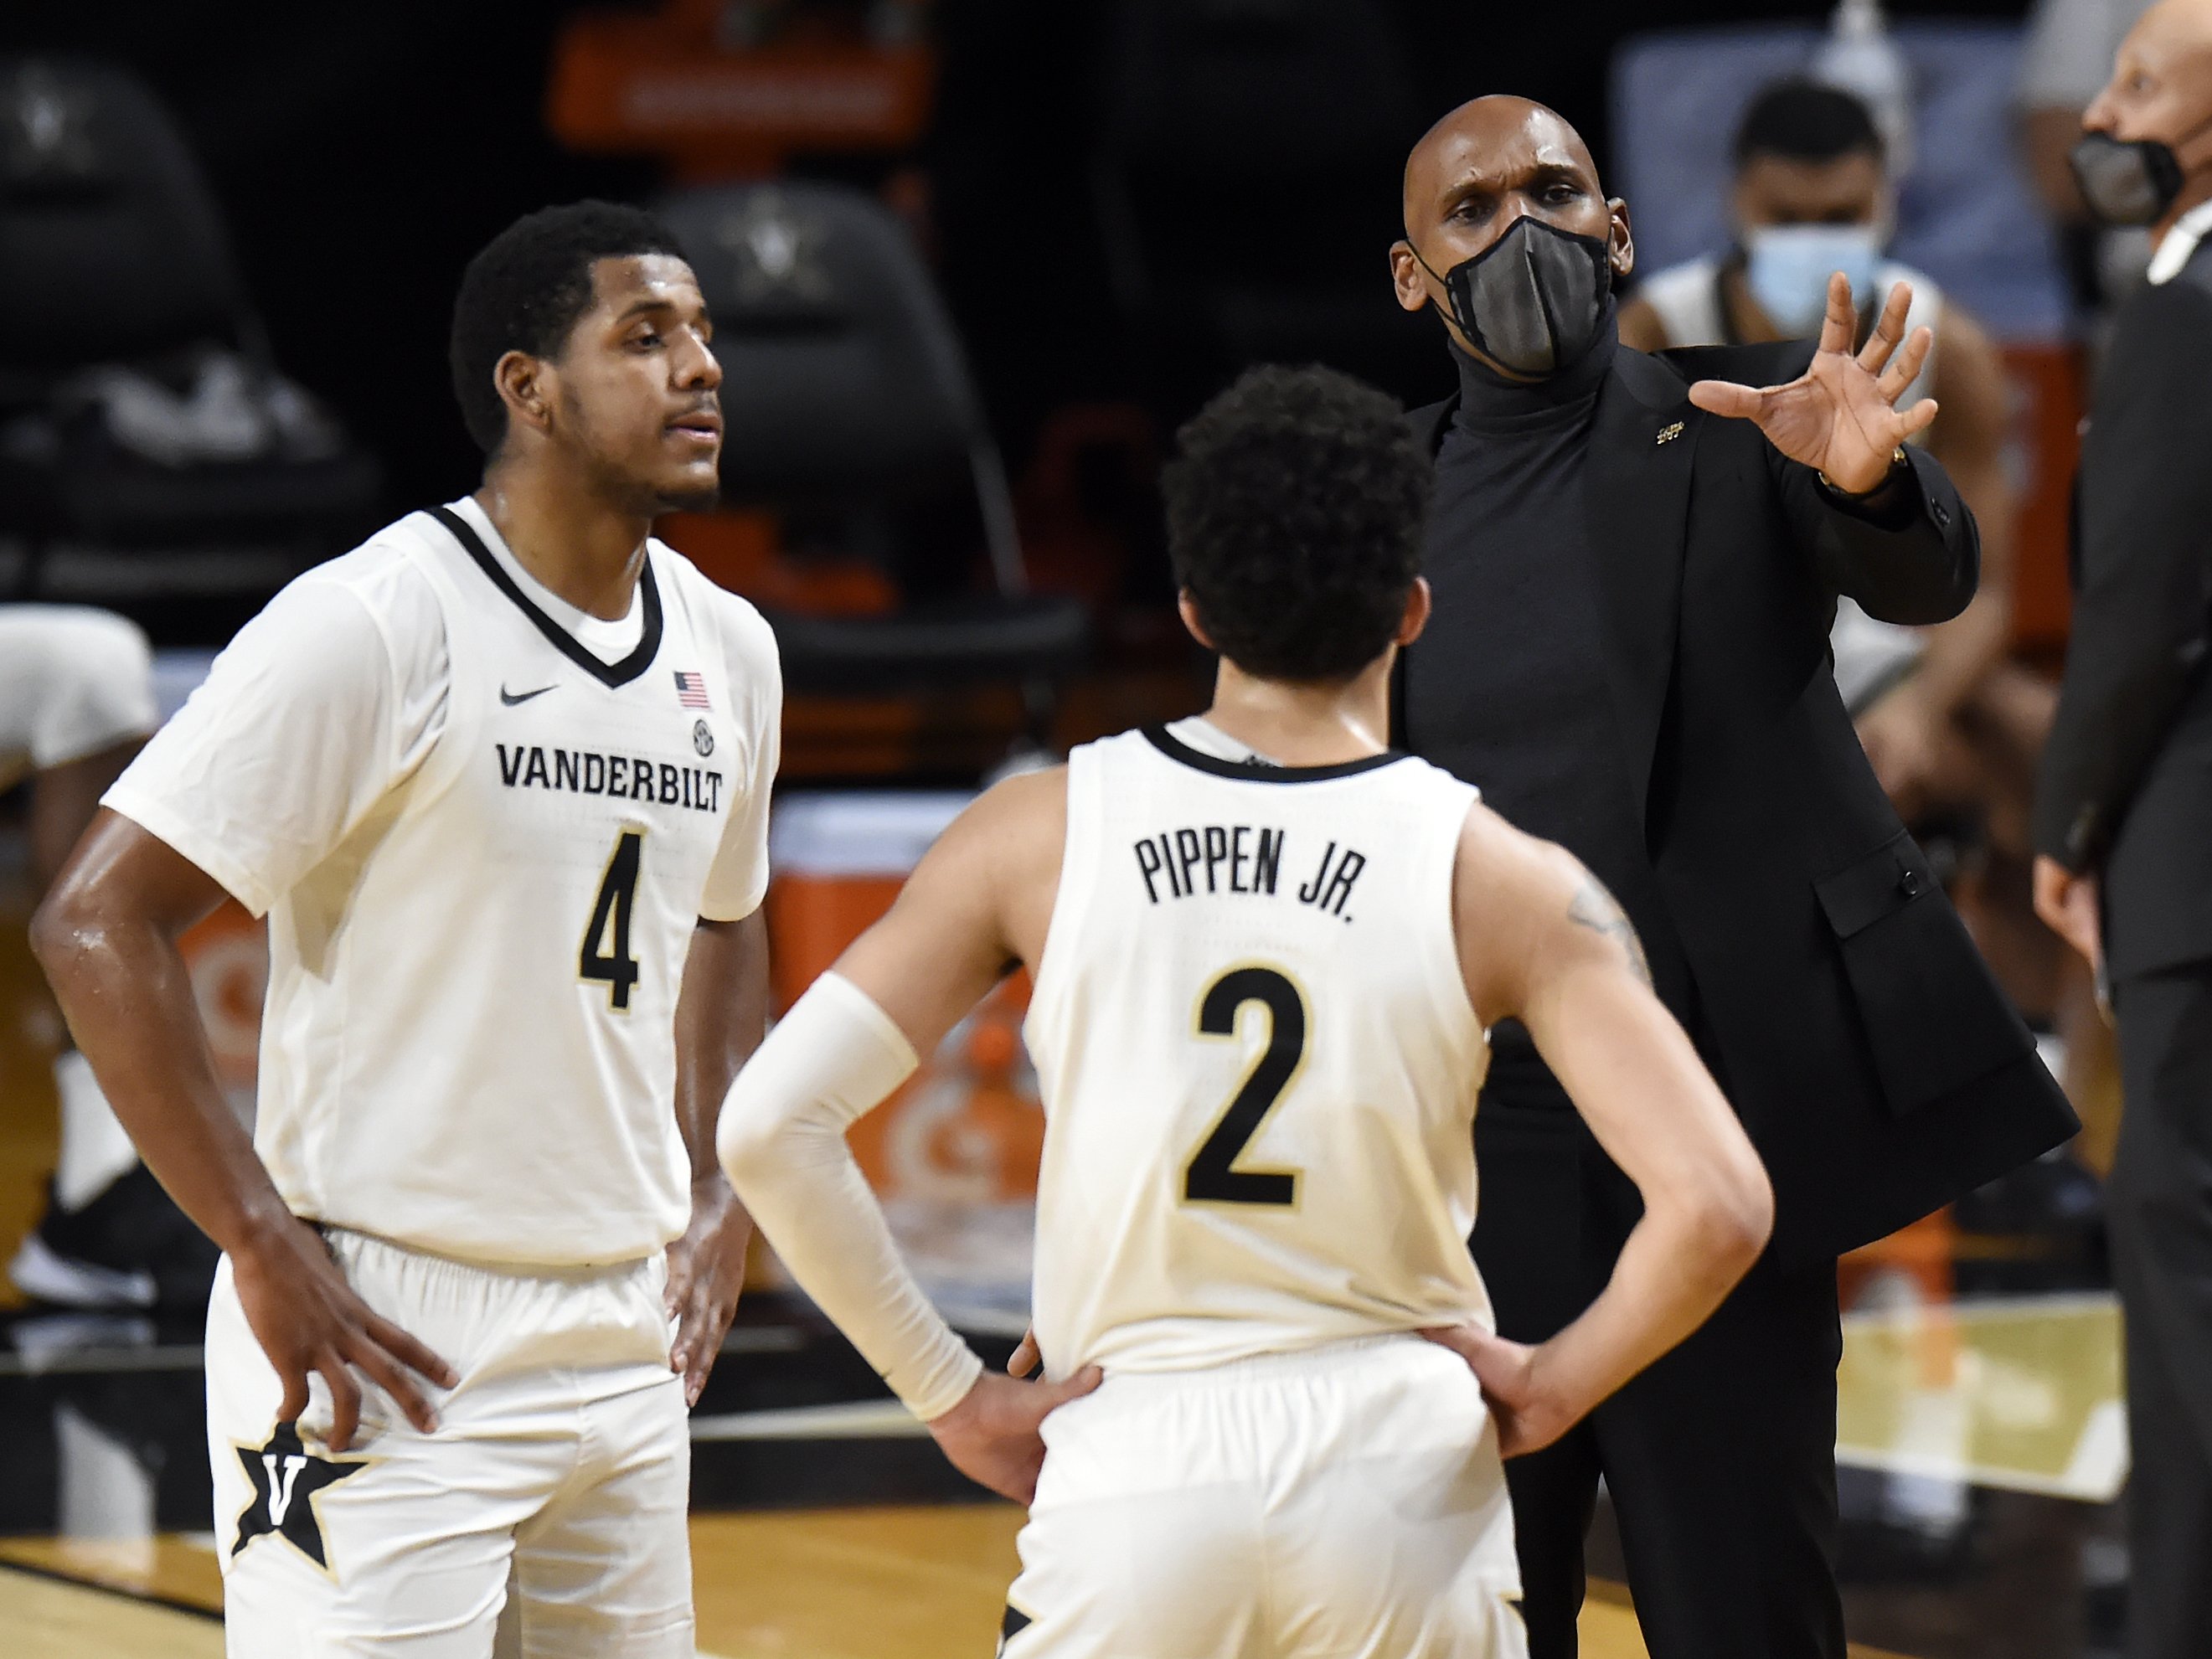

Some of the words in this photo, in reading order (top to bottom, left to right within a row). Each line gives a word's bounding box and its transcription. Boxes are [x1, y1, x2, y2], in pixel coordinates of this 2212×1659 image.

[495, 743, 723, 813] VANDERBILT
[578, 831, 642, 1011] 4
[1133, 825, 1285, 904] PIPPEN
[1299, 841, 1367, 925] JR.
[1183, 966, 1307, 1206] 2
[261, 1454, 308, 1527] V
